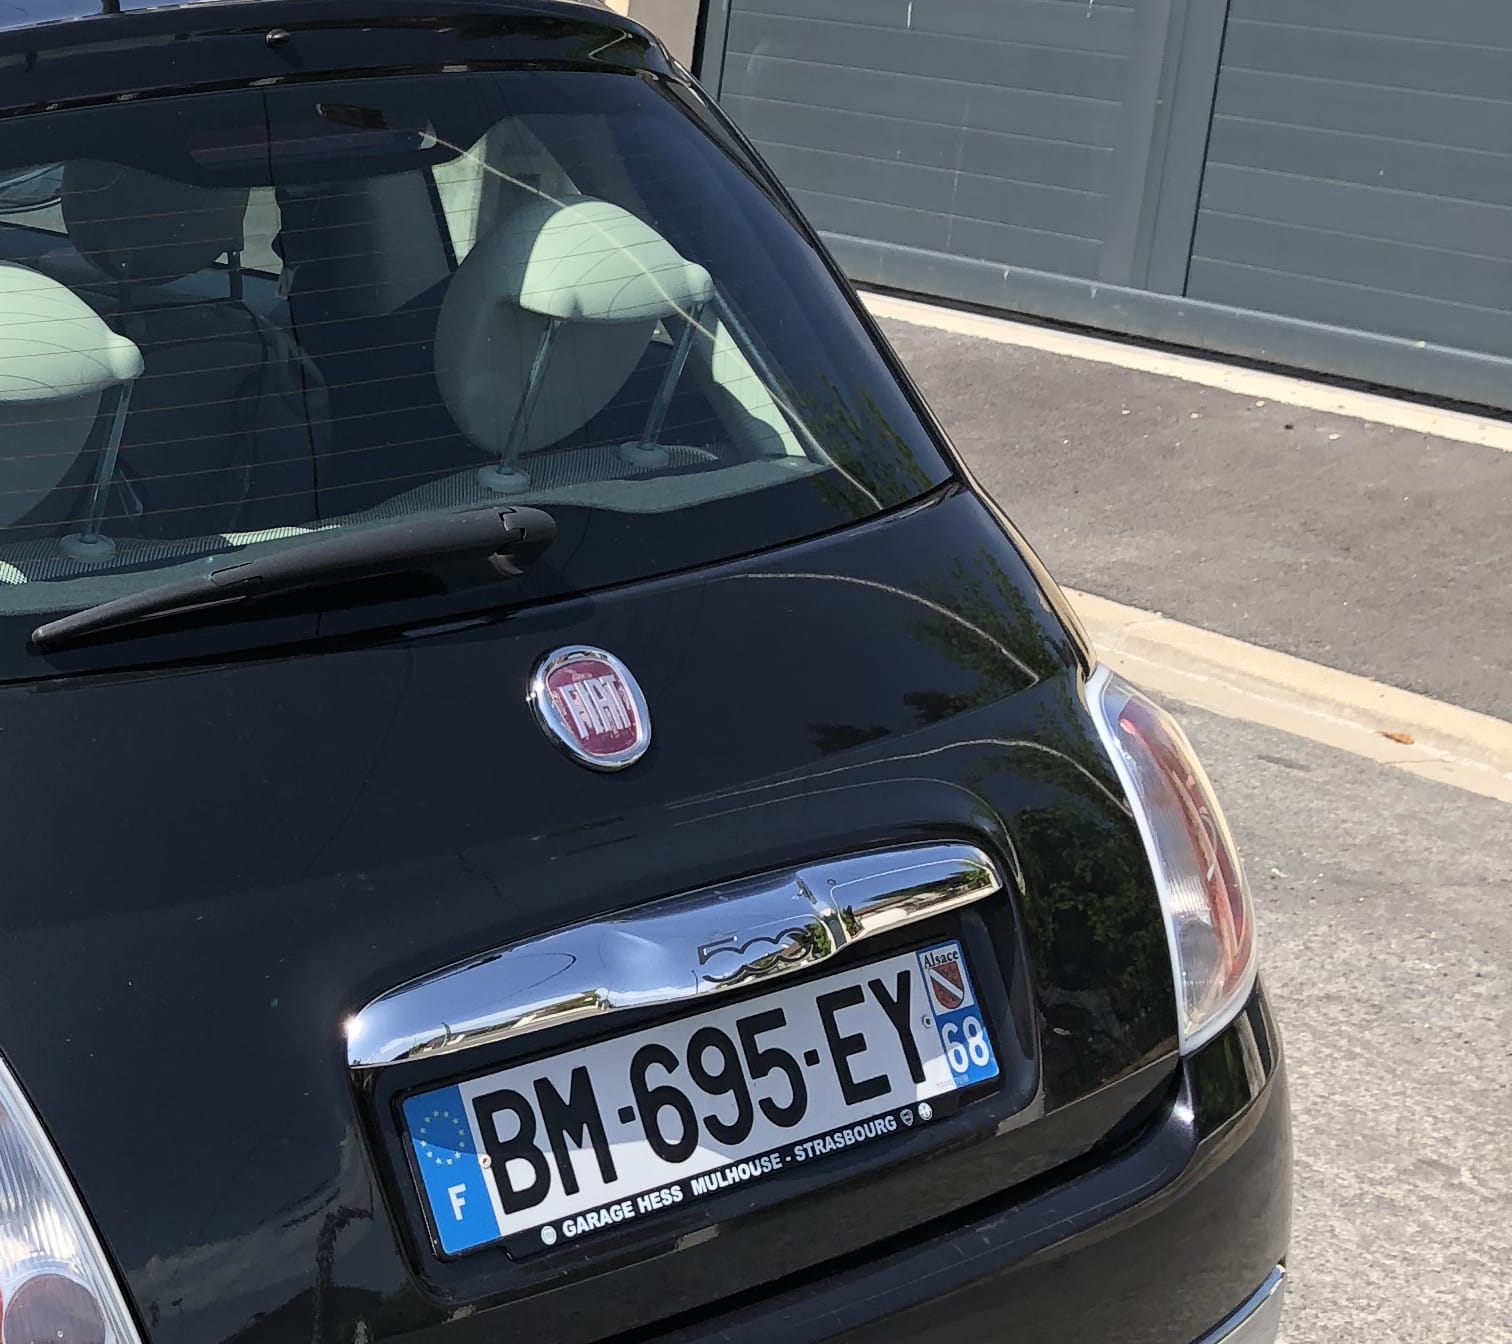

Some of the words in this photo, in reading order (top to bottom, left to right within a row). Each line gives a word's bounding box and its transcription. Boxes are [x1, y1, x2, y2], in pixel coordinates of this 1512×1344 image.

[559, 674, 631, 739] FIAT
[922, 949, 960, 970] Alsace
[941, 1015, 989, 1073] 68
[471, 969, 926, 1215] BM-695-EY
[447, 1183, 467, 1221] F
[562, 1200, 636, 1238] GARAGE
[636, 1184, 684, 1214] HESS
[691, 1152, 783, 1197] MULHOUSE
[794, 1114, 897, 1162] STRASBOURG
